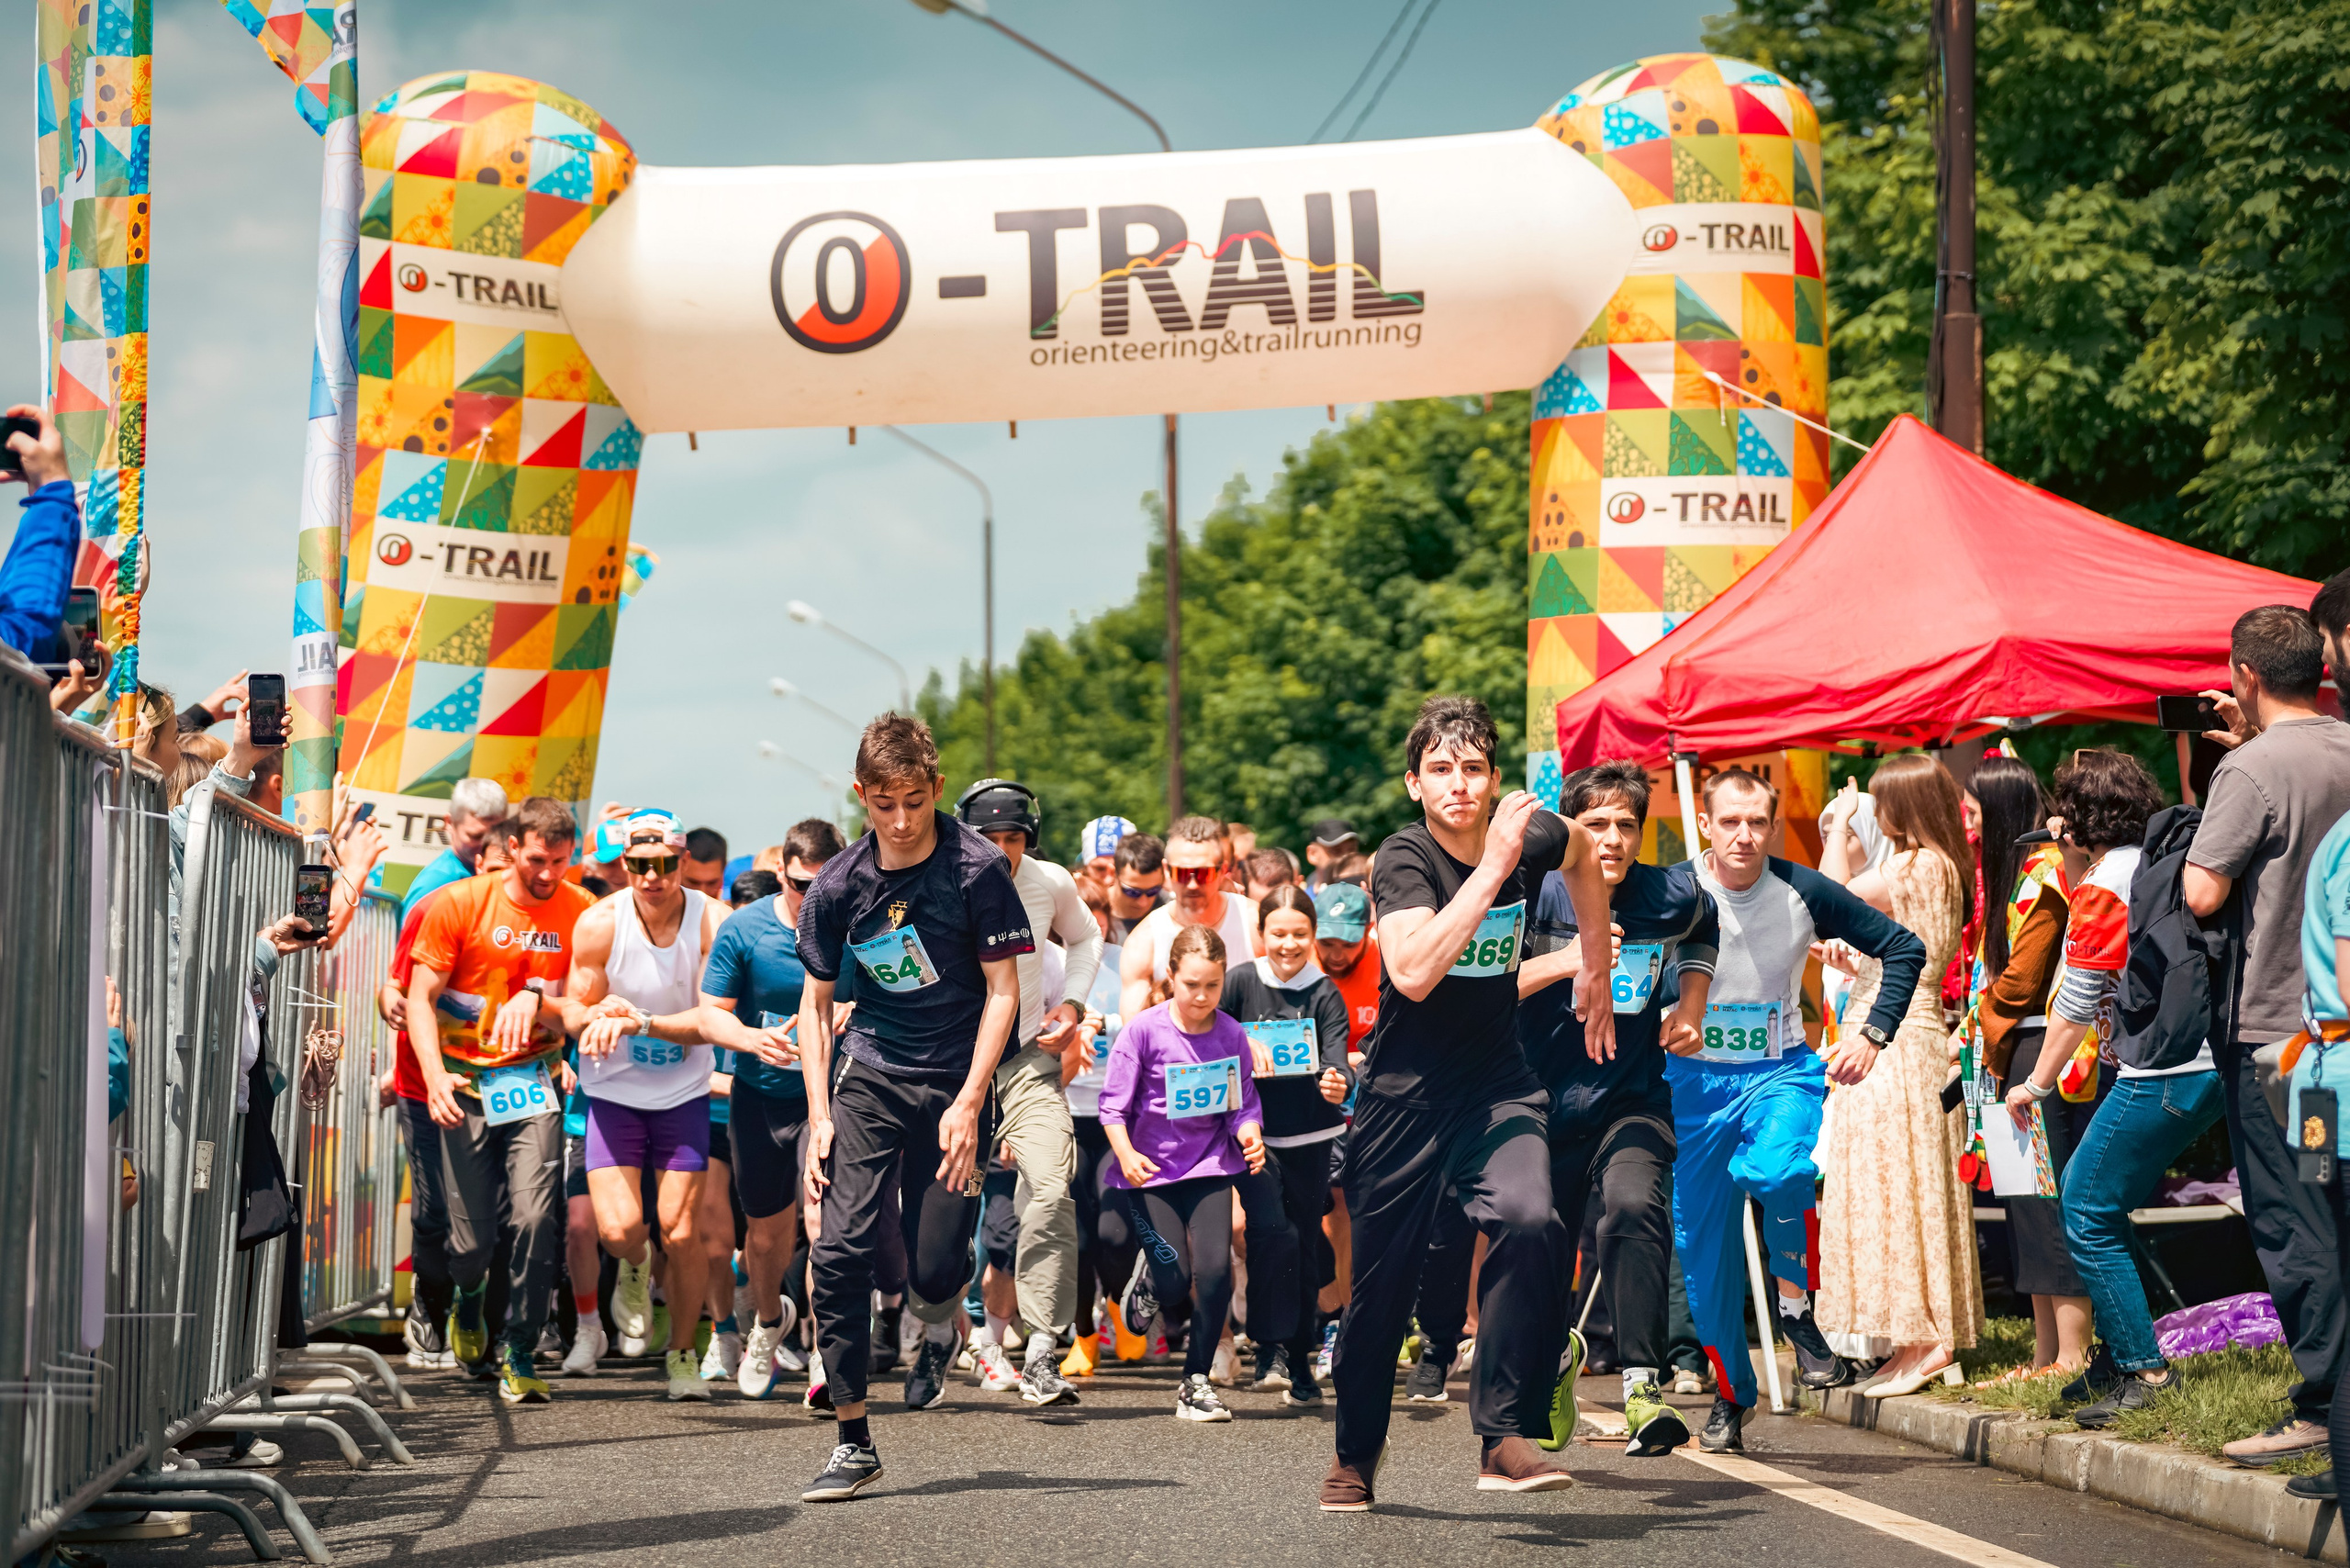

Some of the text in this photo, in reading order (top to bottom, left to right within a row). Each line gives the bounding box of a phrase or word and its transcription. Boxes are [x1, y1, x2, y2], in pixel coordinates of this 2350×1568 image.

[1030, 318, 1423, 366] orienteering&trailrunning
[1612, 974, 1653, 1003] 64
[1704, 1026, 1768, 1051] 838
[632, 1045, 683, 1065] 553
[1272, 1042, 1311, 1067] 62
[490, 1082, 545, 1114] 606
[1175, 1083, 1228, 1110] 597
